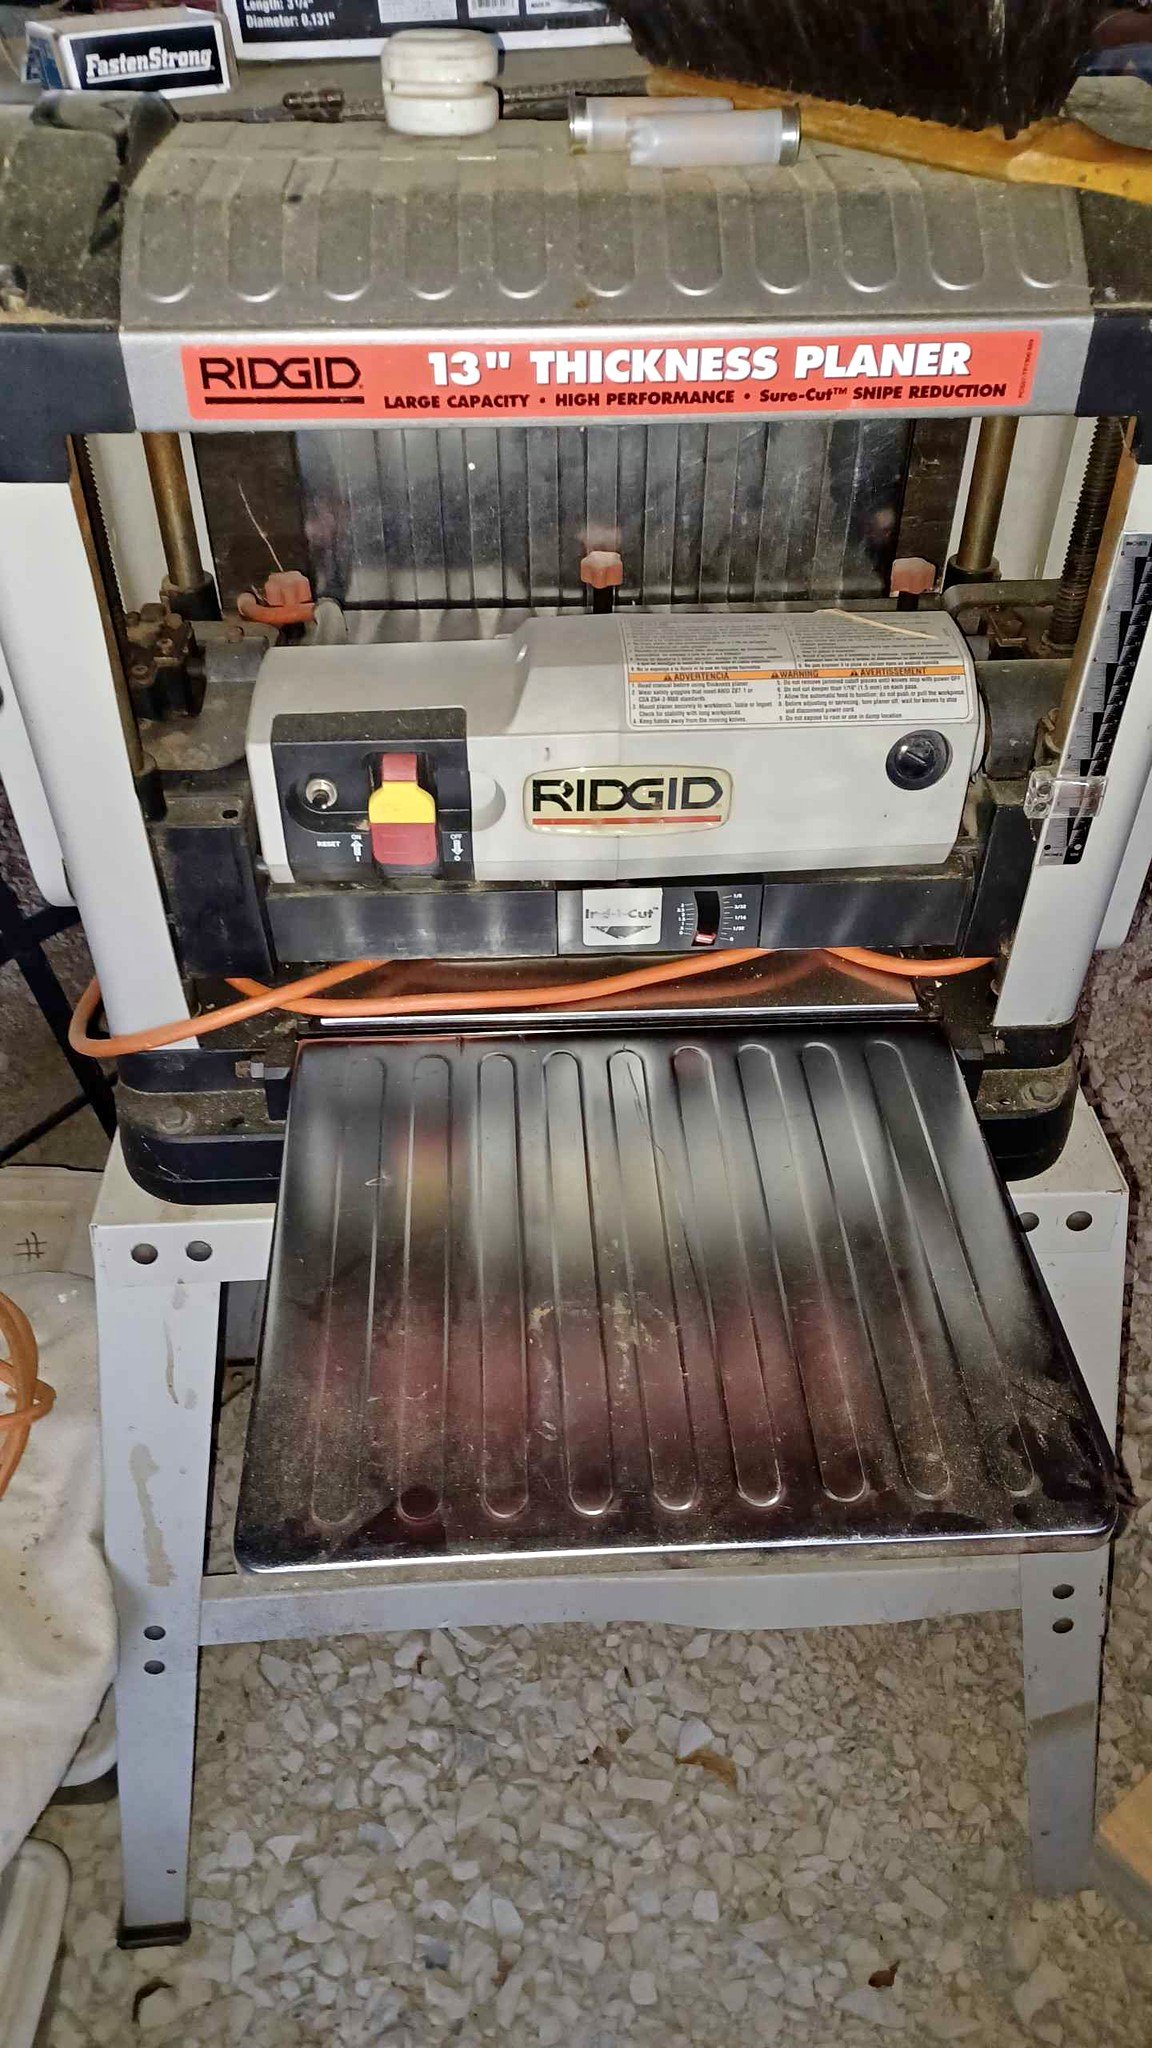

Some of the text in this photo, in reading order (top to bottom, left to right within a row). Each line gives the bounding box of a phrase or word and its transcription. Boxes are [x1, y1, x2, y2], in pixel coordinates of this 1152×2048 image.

[246, 12, 336, 29] Diameter: 0.131"
[86, 46, 212, 78] FastenStrong
[200, 356, 361, 390] RIDGID
[428, 342, 972, 386] 13" THICKNESS PLANER
[384, 396, 440, 410] LARGE
[447, 394, 530, 408] CAPACITY
[555, 393, 600, 407] HIGH
[606, 390, 735, 406] PERFORMANCE
[853, 386, 902, 401] SNIPE
[909, 383, 1007, 400] REDUCTION
[674, 667, 926, 681] ADVERTENCIA WARNING AVERTISSEMENT
[532, 776, 724, 812] RIDGID
